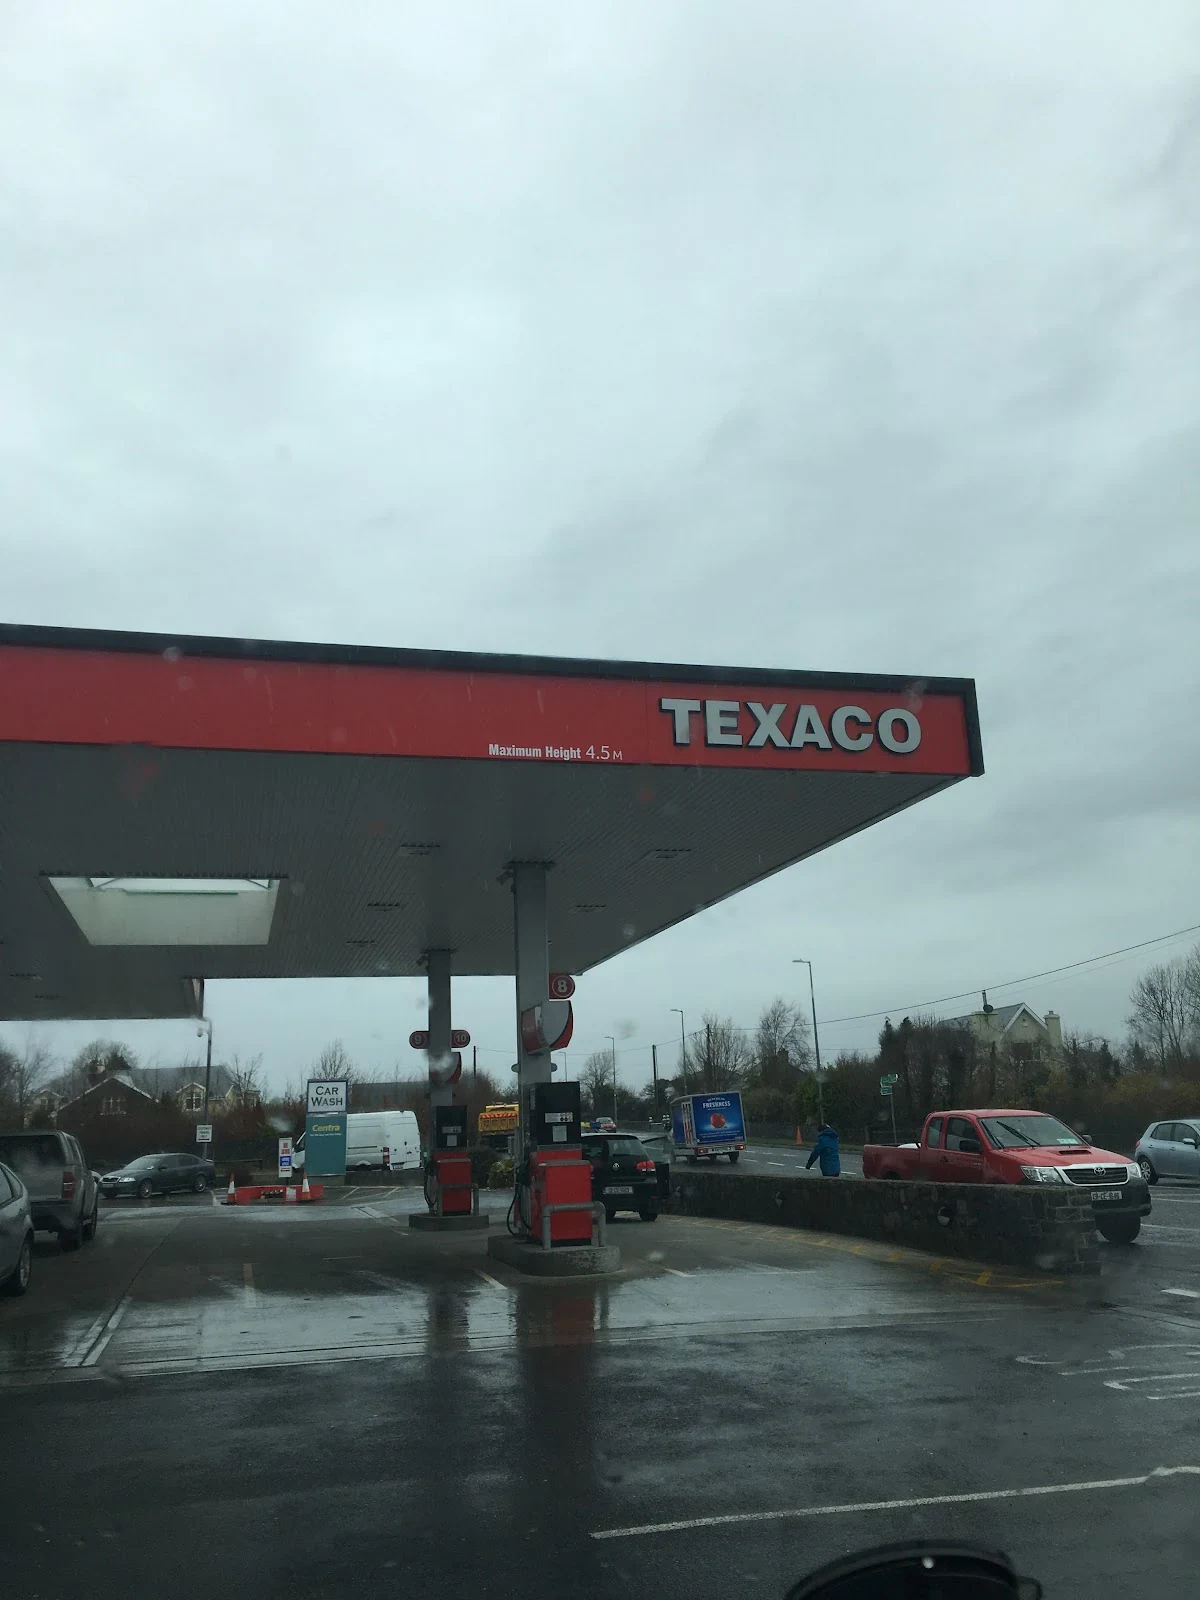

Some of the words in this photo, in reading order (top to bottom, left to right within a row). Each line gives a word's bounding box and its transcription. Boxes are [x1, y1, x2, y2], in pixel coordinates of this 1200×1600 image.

[660, 698, 922, 754] TEXACO
[488, 743, 542, 758] Maximum
[545, 745, 582, 761] Height
[557, 979, 568, 993] 8
[414, 1034, 422, 1045] 9
[455, 1034, 467, 1043] 10
[315, 1086, 339, 1096] CAR
[311, 1096, 343, 1106] WASH
